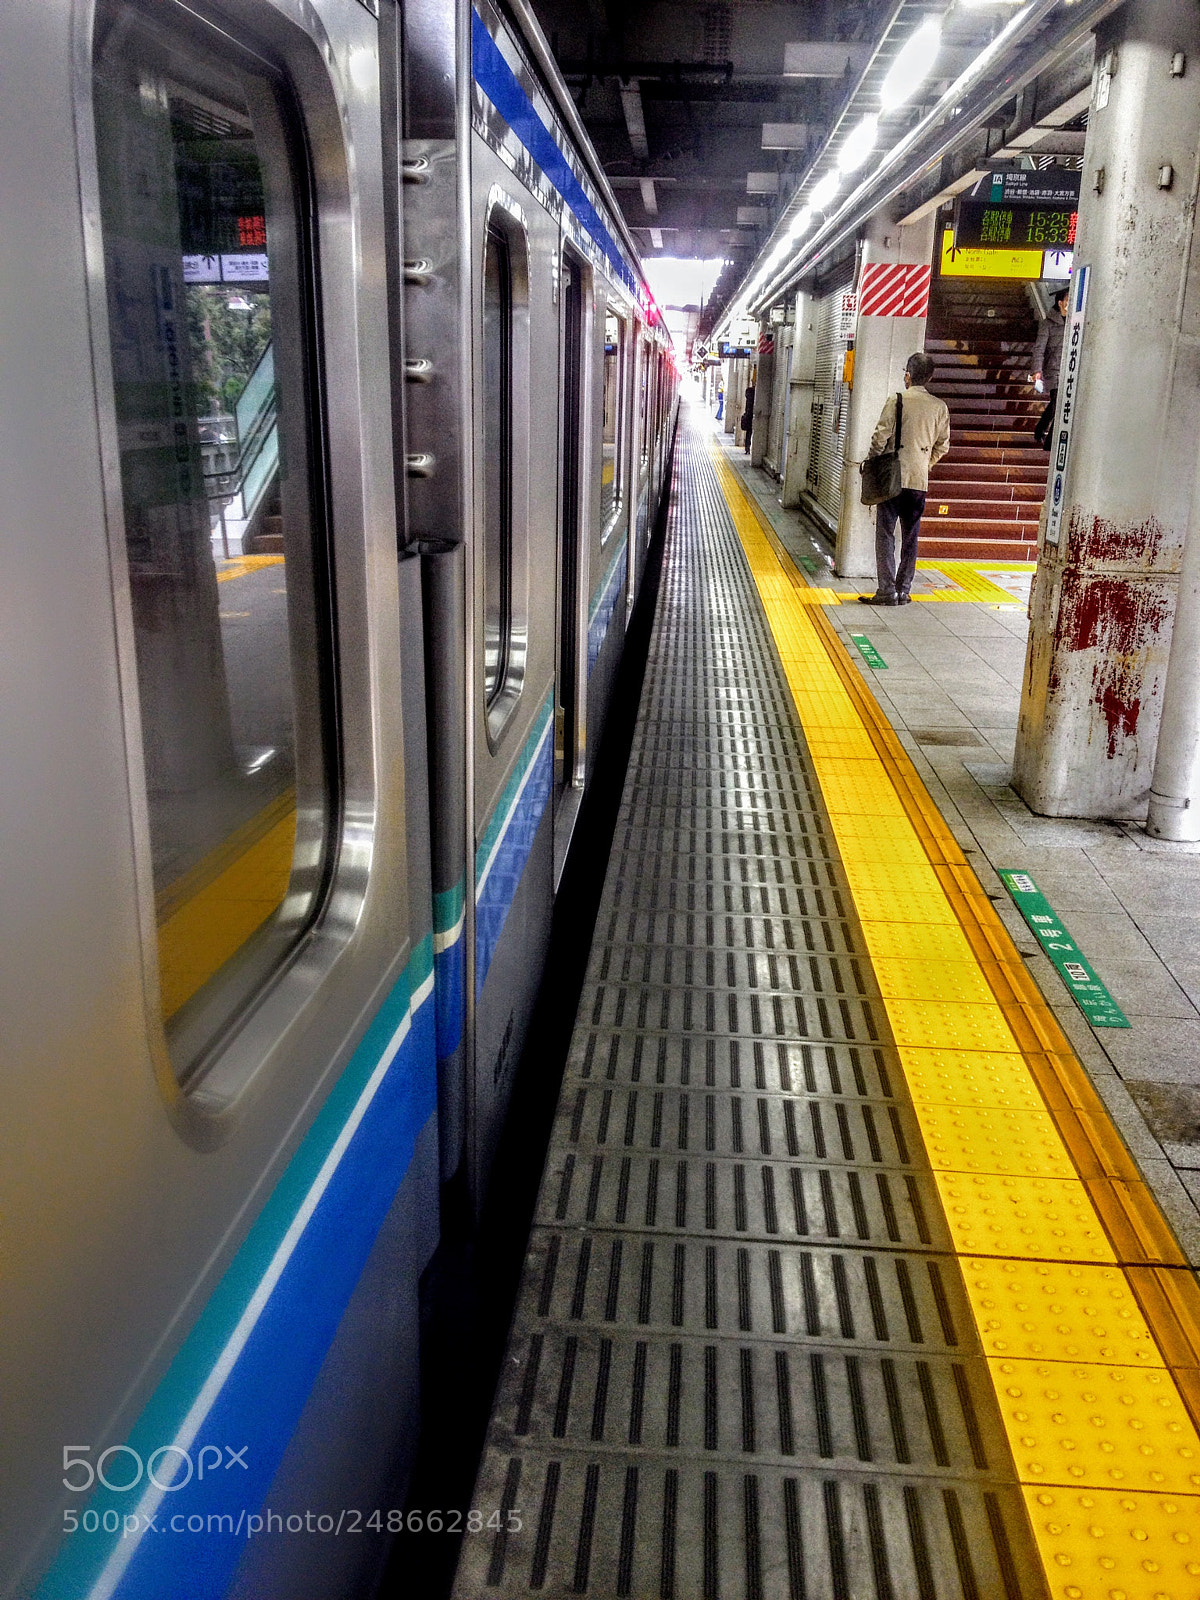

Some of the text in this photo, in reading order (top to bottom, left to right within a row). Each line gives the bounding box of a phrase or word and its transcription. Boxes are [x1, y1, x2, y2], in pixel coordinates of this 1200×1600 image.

[1028, 212, 1069, 227] 15:25
[1026, 227, 1068, 243] 15:33
[1063, 322, 1080, 424] おおさき
